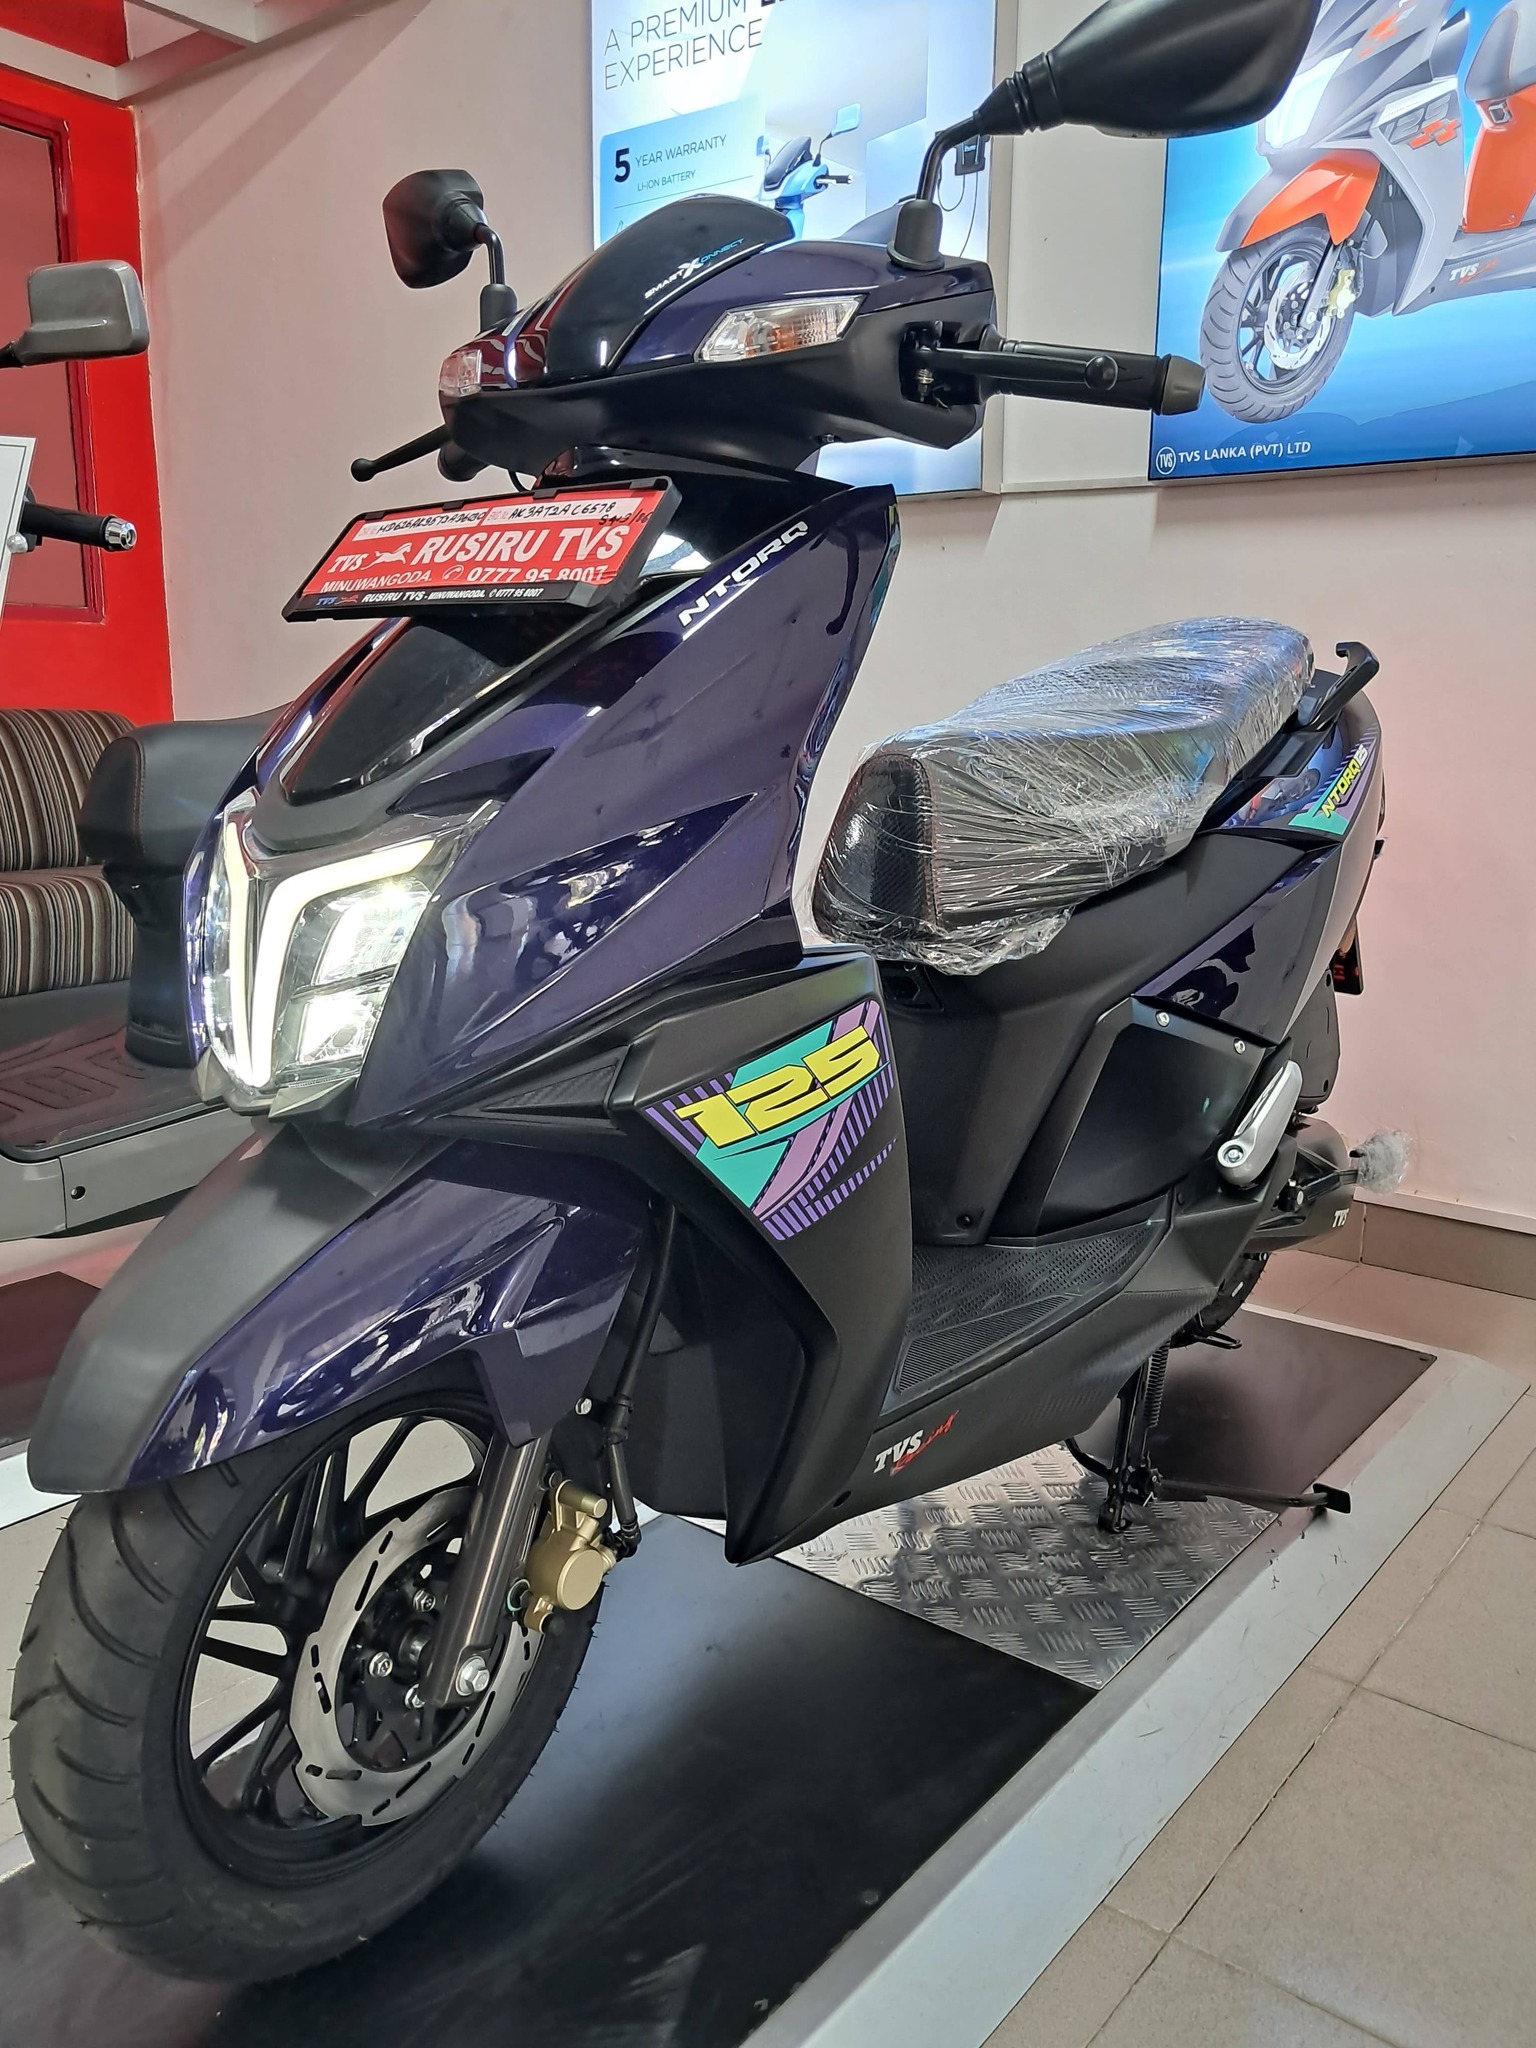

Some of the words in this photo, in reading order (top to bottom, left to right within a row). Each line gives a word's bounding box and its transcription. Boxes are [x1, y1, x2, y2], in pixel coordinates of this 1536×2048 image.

[604, 28, 621, 57] A
[630, 0, 747, 48] PREMIUM
[604, 18, 763, 91] EXPERIENCE
[614, 147, 631, 183] 5
[635, 150, 663, 168] YEAR
[665, 134, 728, 161] WARRANTY
[637, 177, 660, 192] LI-ION
[661, 169, 697, 187] BATTERY
[1449, 262, 1479, 282] TVS
[1178, 449, 1201, 464] TVS
[1204, 445, 1247, 461] LANKA
[1250, 442, 1284, 459] (PVT)
[1287, 441, 1312, 455] LTD
[327, 552, 369, 574] TVS
[410, 528, 551, 566] RUSIRU
[552, 523, 630, 562] TVS
[320, 569, 433, 594] MINUWANGODA.
[466, 566, 521, 583] 0777
[523, 568, 553, 583] 95
[556, 565, 609, 583] 8007
[677, 520, 809, 627] NTORQ
[316, 596, 338, 607] TVS
[361, 591, 401, 603] RUSIRU
[402, 590, 426, 601] TVS
[495, 588, 515, 598] 0777
[673, 1025, 881, 1150] 125
[1332, 1207, 1350, 1229] TVS
[872, 1428, 924, 1474] TVS
